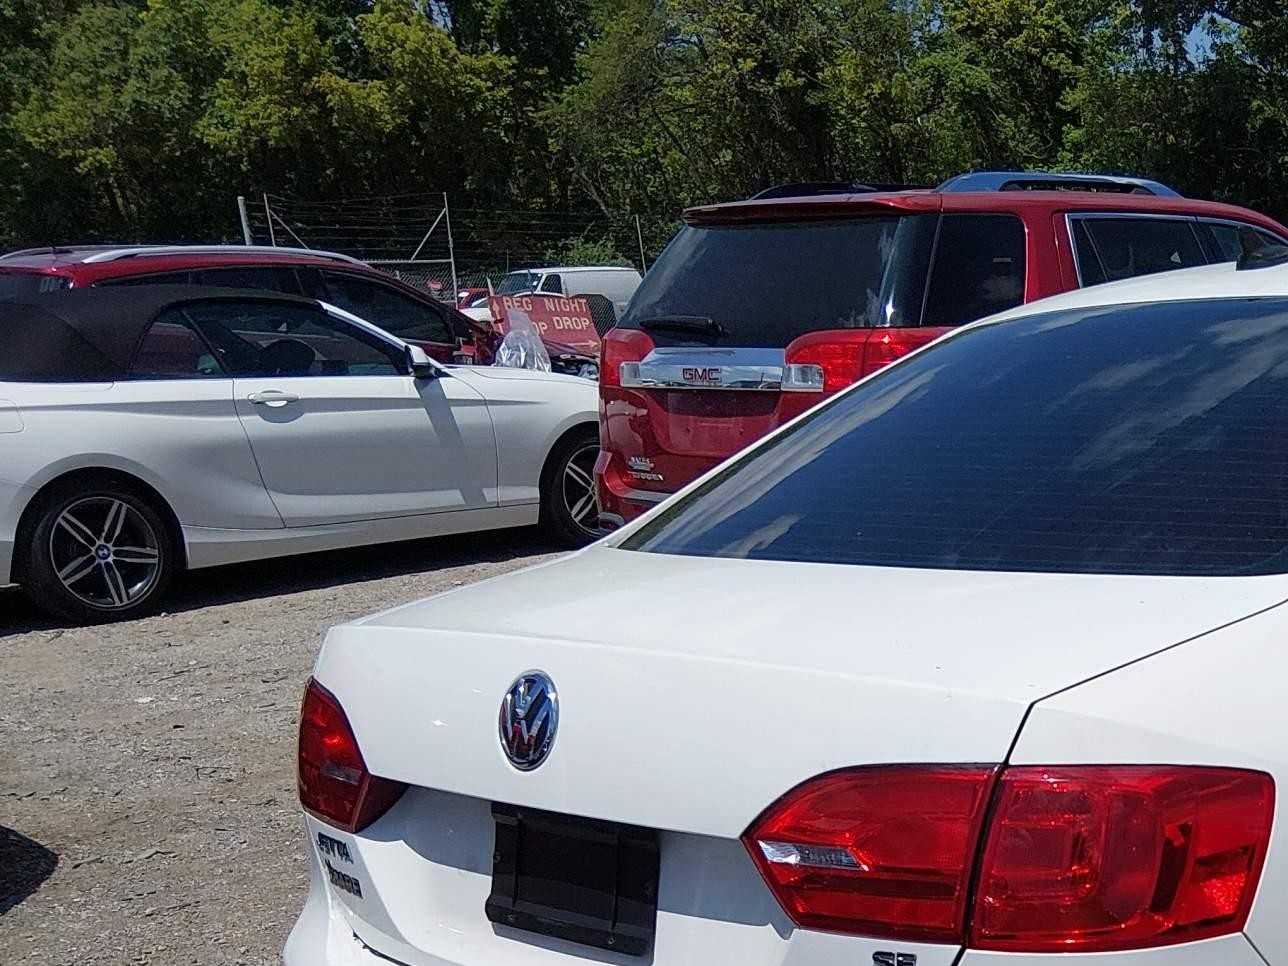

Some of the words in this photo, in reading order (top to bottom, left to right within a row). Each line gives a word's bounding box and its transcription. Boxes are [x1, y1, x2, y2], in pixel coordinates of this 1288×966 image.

[543, 297, 588, 312] NIGHT
[552, 316, 590, 330] DROP
[682, 367, 722, 381] GMC
